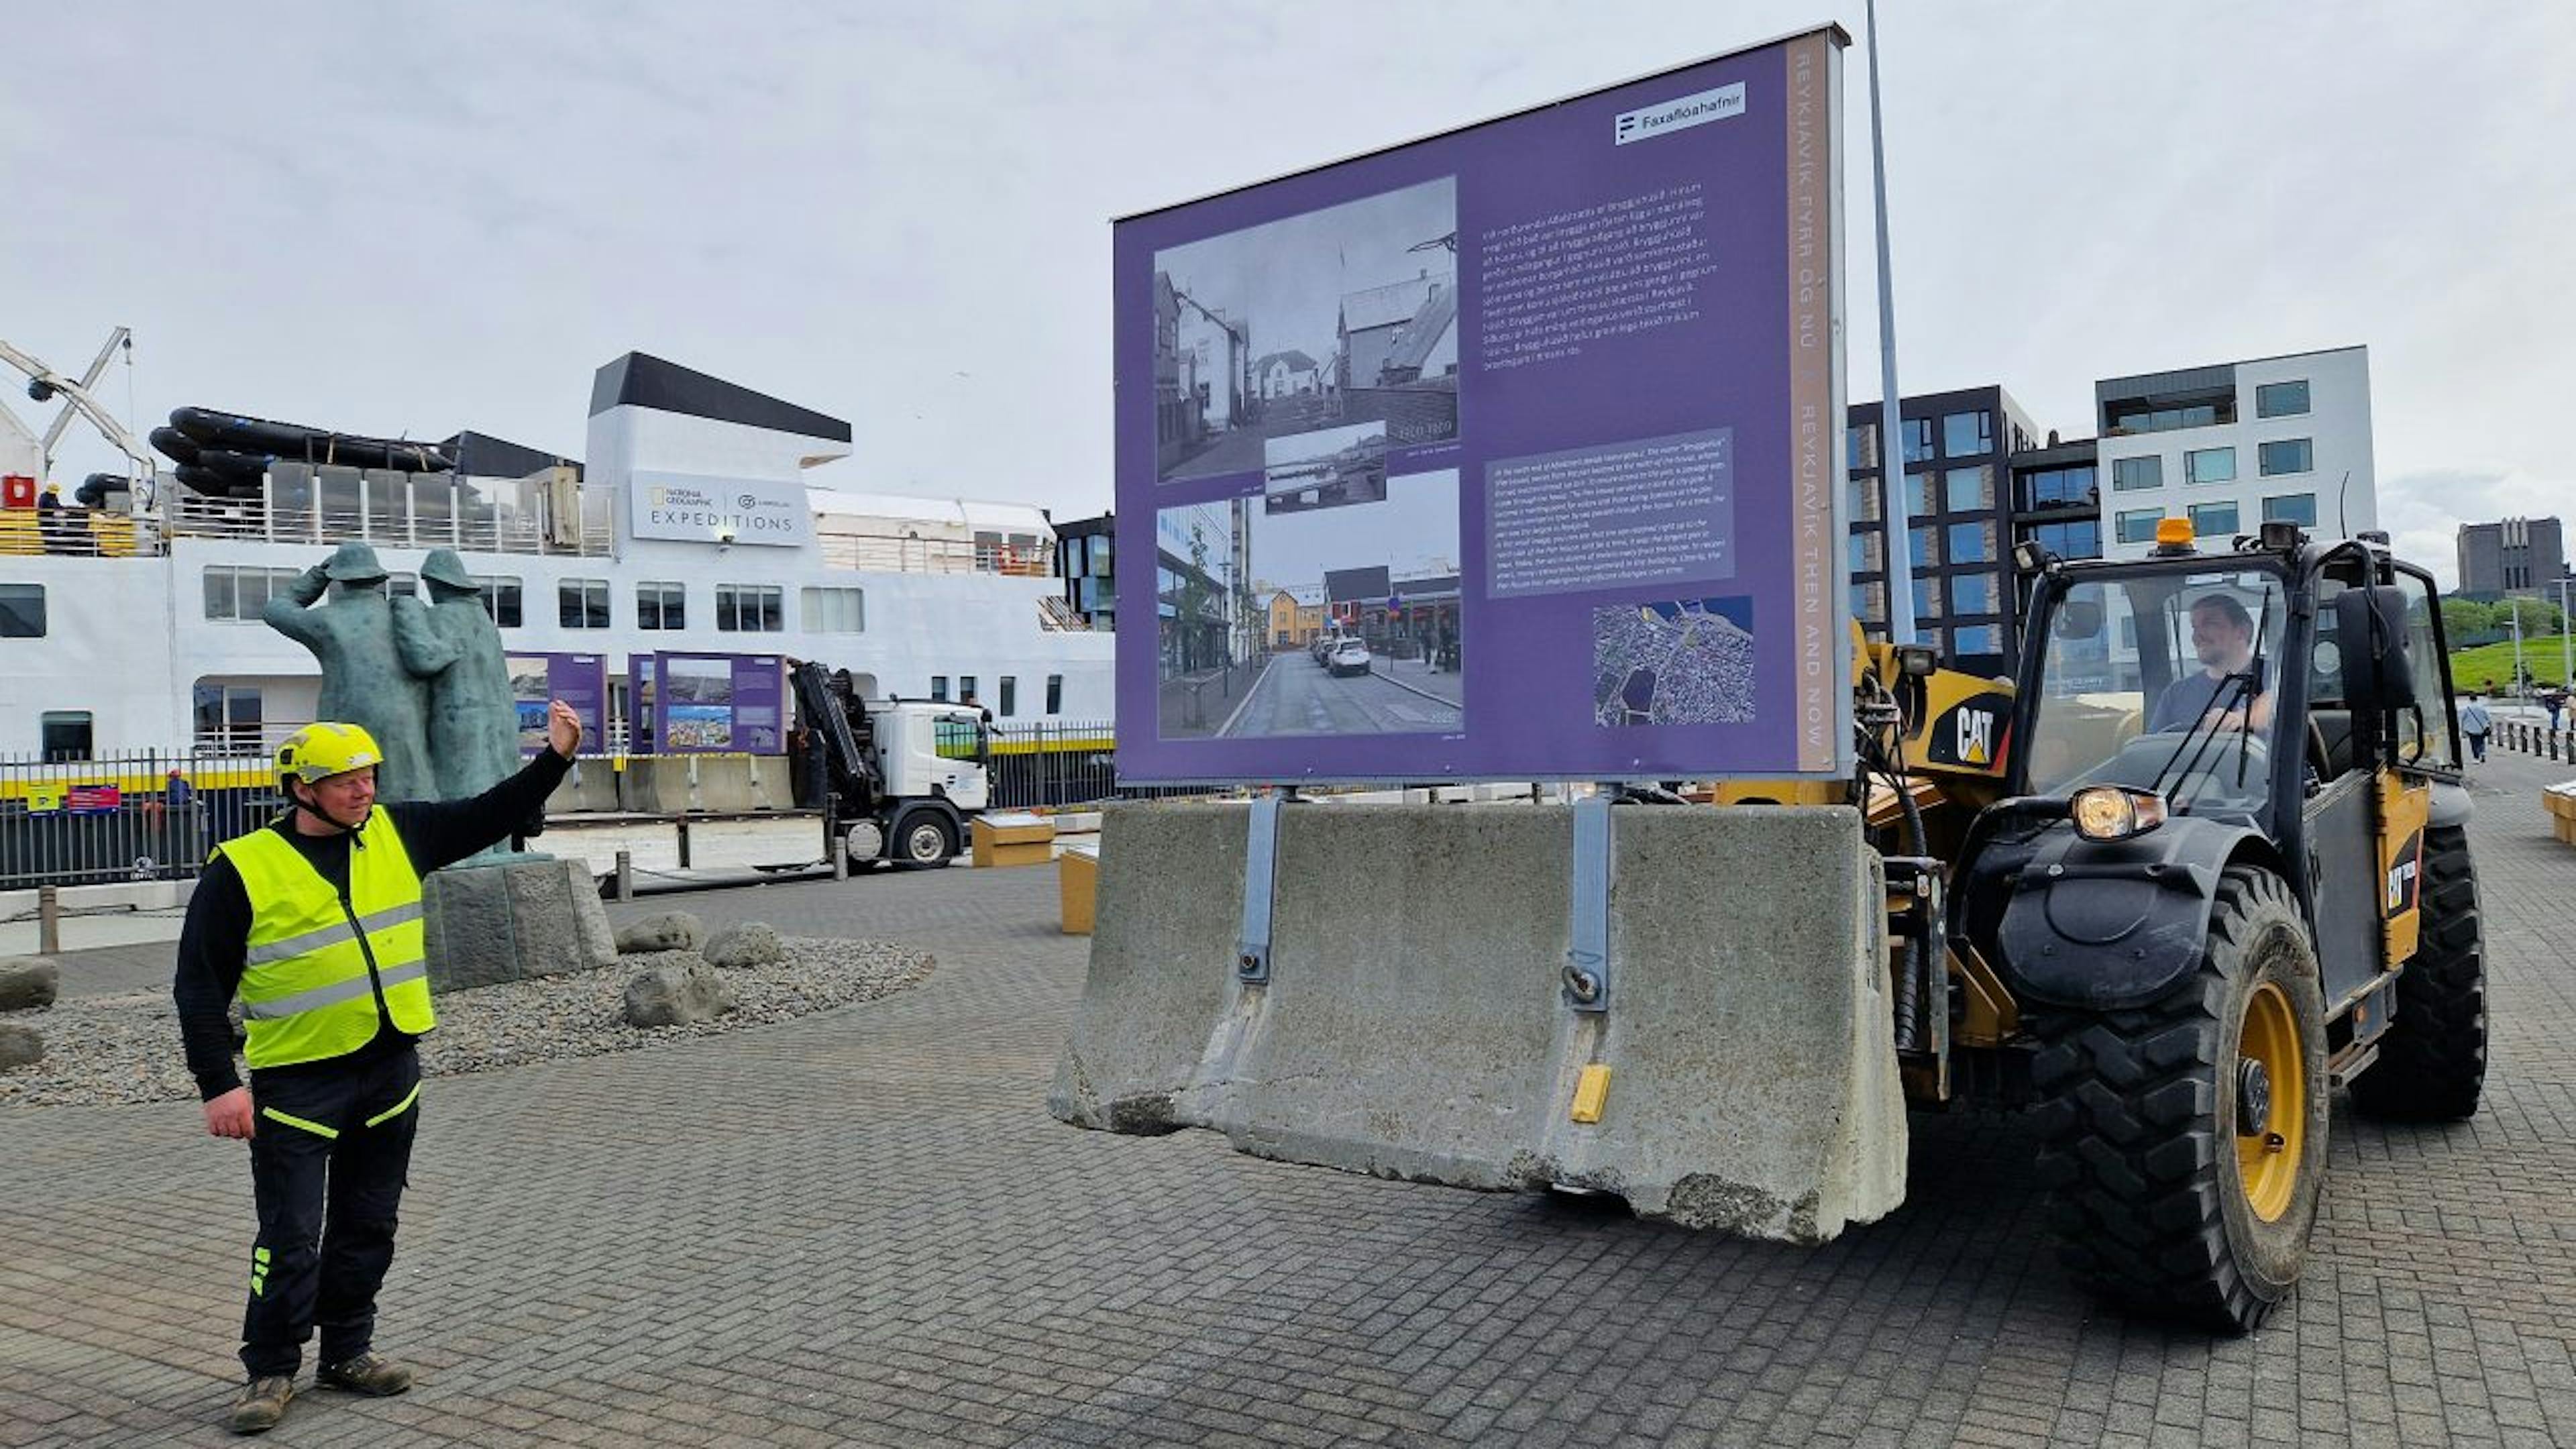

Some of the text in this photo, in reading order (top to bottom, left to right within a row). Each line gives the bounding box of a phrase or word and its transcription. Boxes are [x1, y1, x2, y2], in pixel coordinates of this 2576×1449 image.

[1642, 95, 1741, 129] Faxaflóahafnir
[1799, 197, 1814, 257] FYRR
[1801, 268, 1815, 303] OG
[1801, 314, 1819, 347] NÚ
[651, 511, 792, 532] EXPEDITIONS
[1803, 406, 1823, 746] REYKJAVÍK THEN AND NOW
[1957, 706, 1994, 763] CAT
[2388, 865, 2403, 910] CAT
